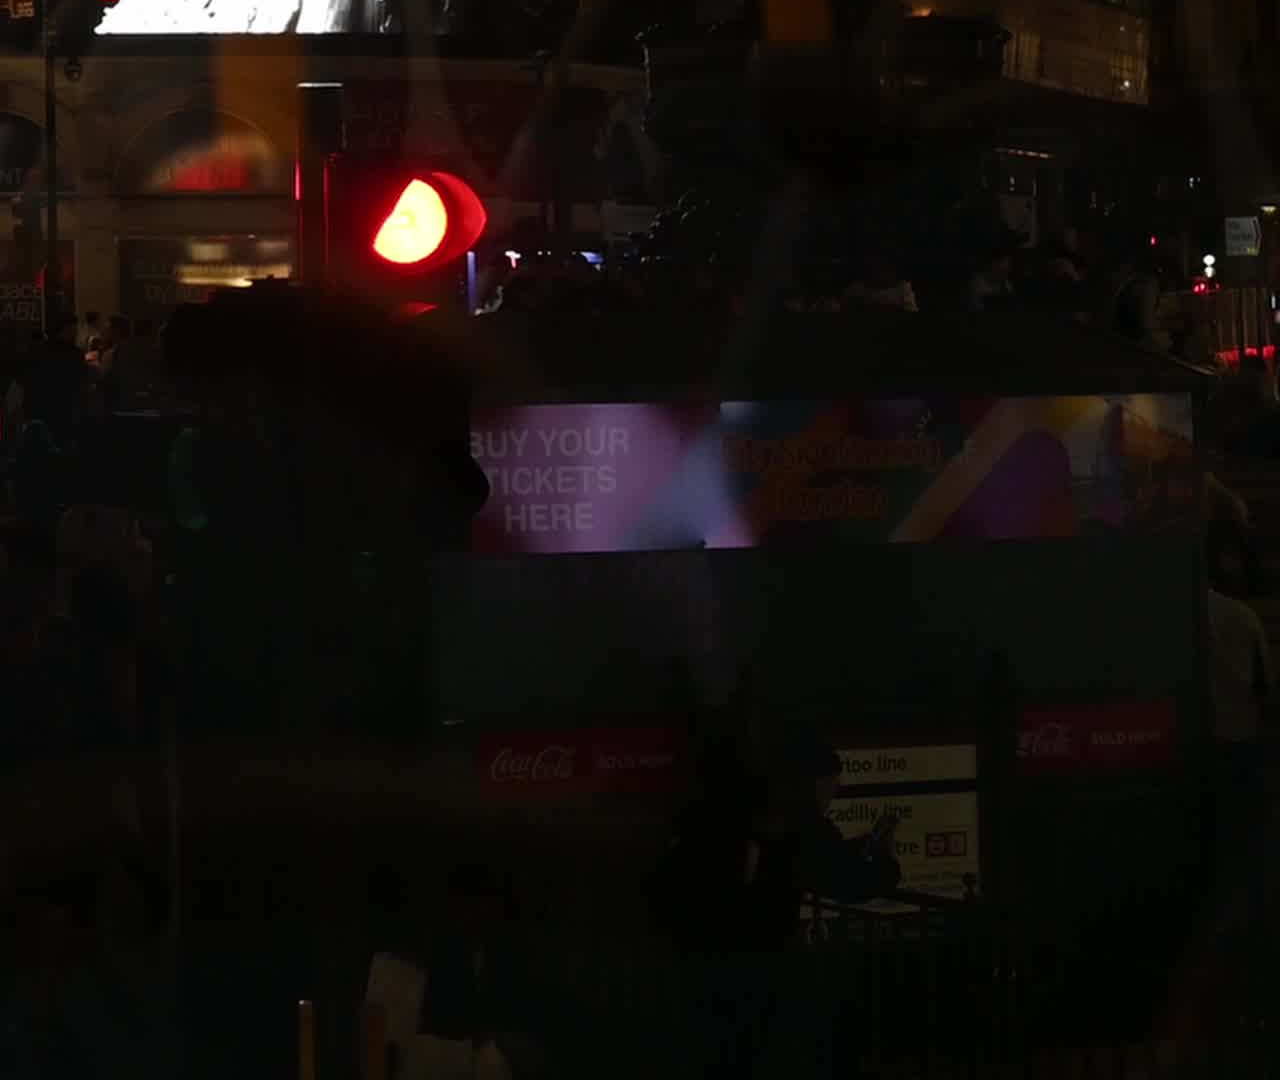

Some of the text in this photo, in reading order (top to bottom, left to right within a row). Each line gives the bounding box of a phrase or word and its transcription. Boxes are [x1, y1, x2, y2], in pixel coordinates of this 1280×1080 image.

[467, 426, 631, 458] BUY YOUR
[485, 466, 617, 496] TICKETS
[504, 503, 593, 534] HERE
[878, 752, 907, 771] line
